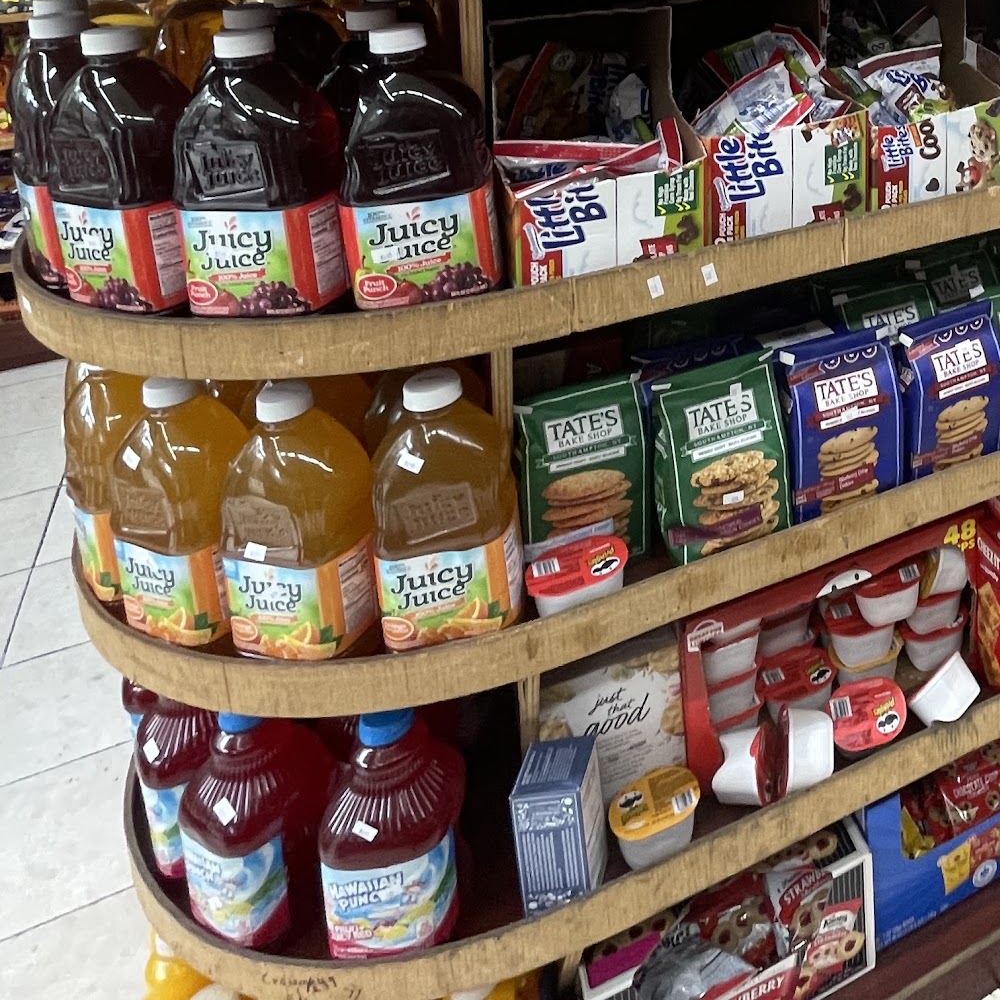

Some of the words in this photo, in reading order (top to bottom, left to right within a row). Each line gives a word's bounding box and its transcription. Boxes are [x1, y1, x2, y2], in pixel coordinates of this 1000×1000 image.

[883, 135, 905, 169] Little
[920, 118, 942, 160] Coo
[716, 137, 767, 203] Little
[747, 131, 784, 179] Bite
[564, 184, 608, 224] Bit
[369, 213, 459, 247] Juicy
[525, 195, 586, 250] Littl
[68, 242, 111, 261] Juice
[201, 251, 266, 271] Juice
[384, 236, 452, 263] uice
[363, 285, 389, 294] Punch
[364, 279, 385, 288] Fruit
[934, 343, 982, 372] TATES
[817, 371, 874, 401] TATE'S
[548, 409, 618, 441] TATE'S
[688, 394, 752, 429] TATES
[697, 422, 722, 436] BAKE
[724, 414, 748, 429] SHOP
[557, 435, 585, 449] BAKE
[587, 427, 613, 442] SHOP
[943, 519, 977, 545] 48
[131, 577, 172, 598] Juice
[391, 563, 474, 595] Juicy
[245, 595, 297, 613] Juice
[398, 580, 466, 610] Juice
[584, 692, 652, 737] good
[588, 686, 627, 716] just
[607, 698, 635, 717] that
[328, 870, 404, 900] HAWAIIAN
[338, 891, 388, 913] PUNC
